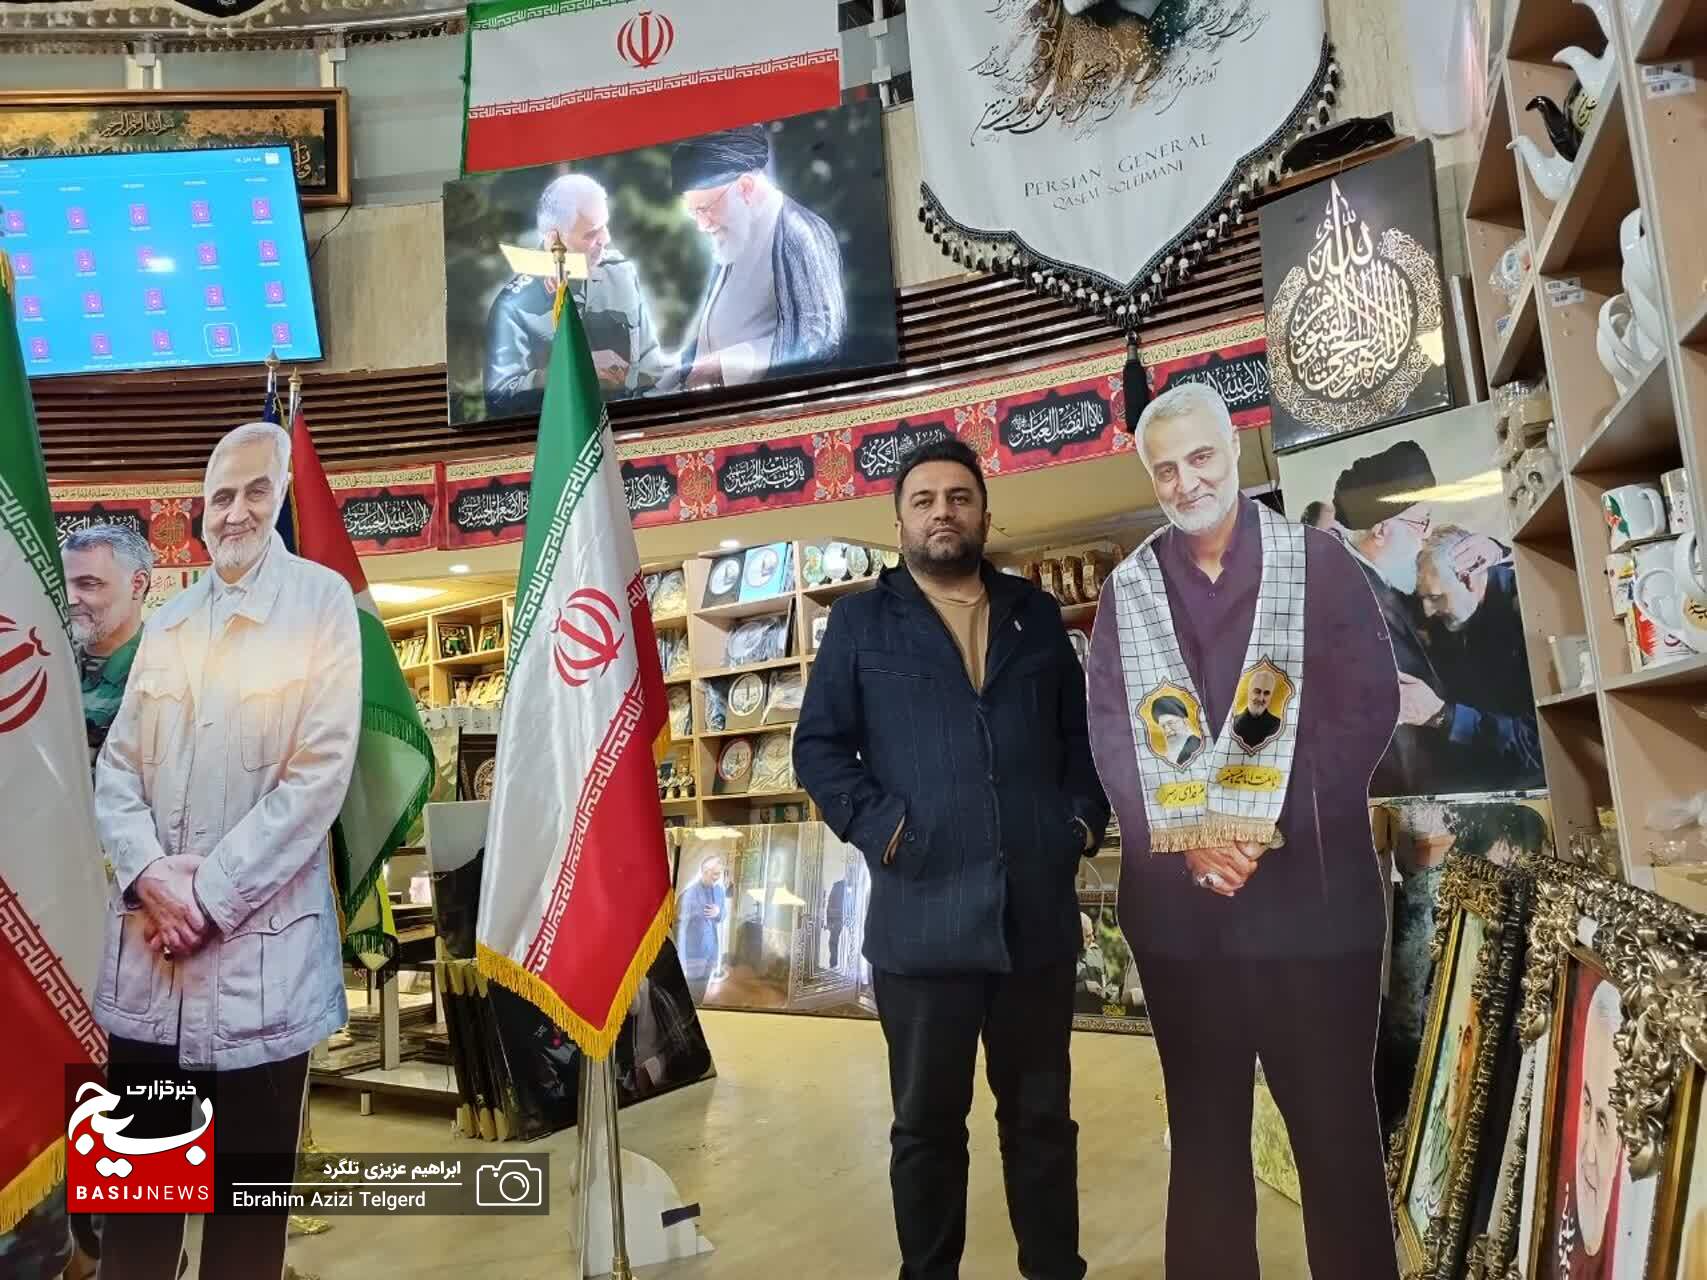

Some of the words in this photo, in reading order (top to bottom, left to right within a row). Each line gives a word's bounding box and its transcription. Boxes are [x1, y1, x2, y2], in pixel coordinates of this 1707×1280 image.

[1024, 167, 1101, 197] PERSIAN
[1118, 133, 1211, 173] GENERAL
[1052, 187, 1101, 211] QASEM
[1108, 160, 1184, 194] SOLEIMANI
